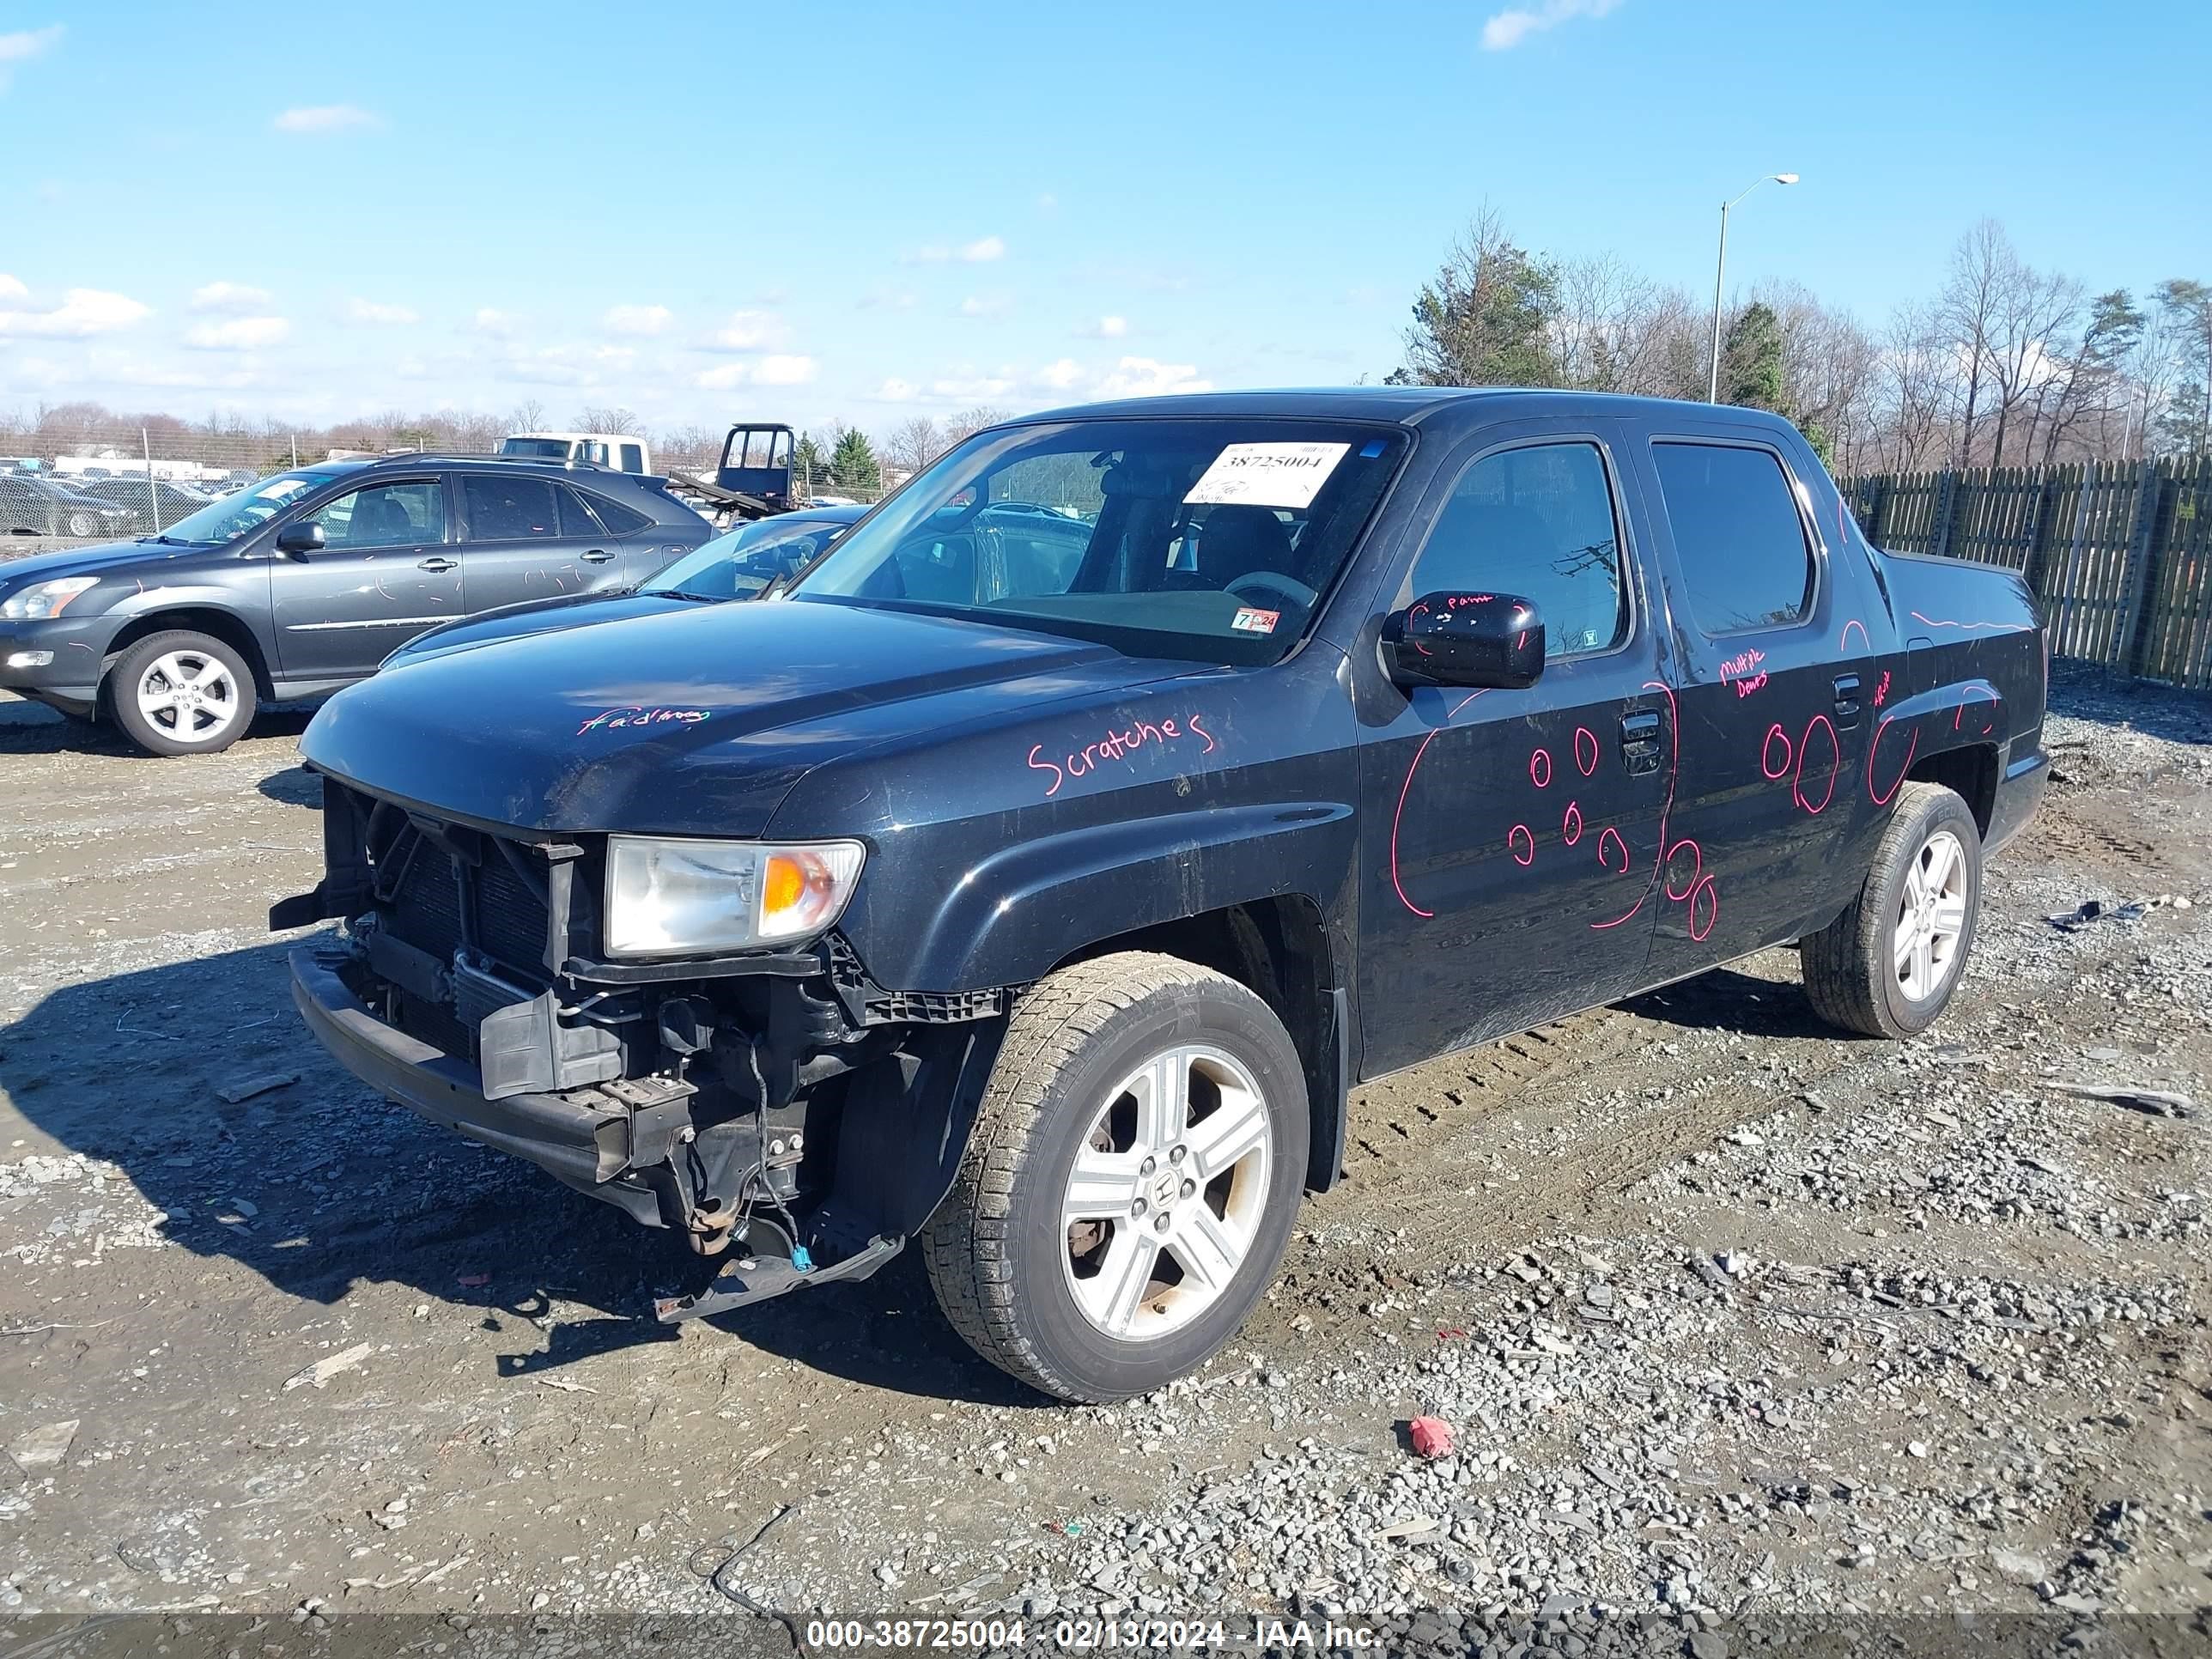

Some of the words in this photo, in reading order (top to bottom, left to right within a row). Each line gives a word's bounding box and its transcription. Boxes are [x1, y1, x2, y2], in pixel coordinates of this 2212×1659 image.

[1222, 455, 1324, 468] 38725004
[1239, 613, 1250, 626] 7
[1261, 616, 1275, 626] 24
